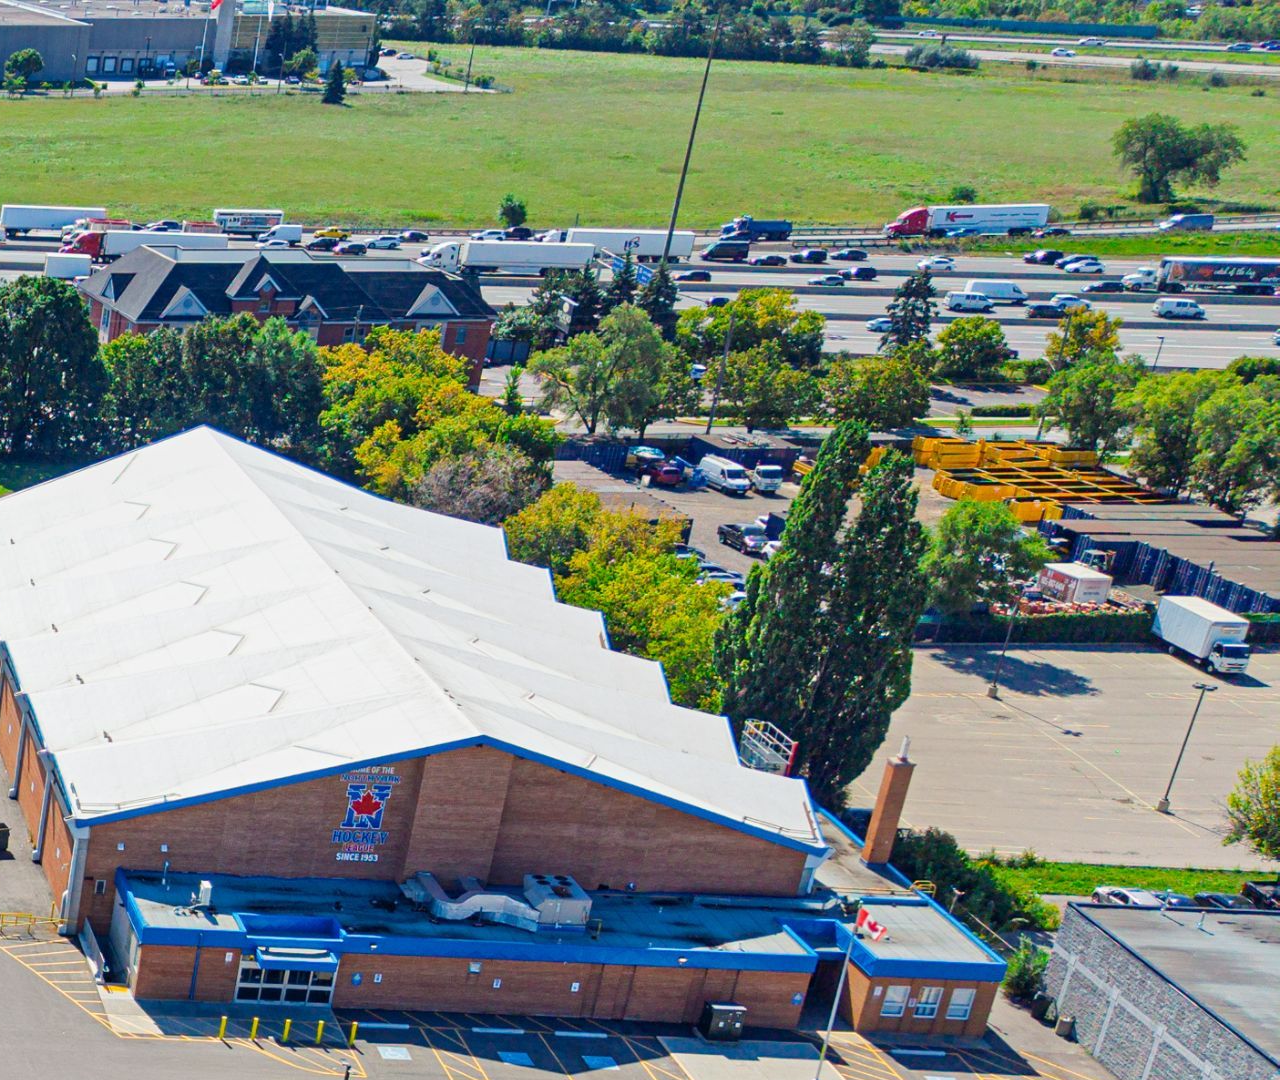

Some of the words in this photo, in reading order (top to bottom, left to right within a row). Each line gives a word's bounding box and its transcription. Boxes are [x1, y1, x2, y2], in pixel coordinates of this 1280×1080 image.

[331, 829, 389, 846] HOCKEY
[336, 852, 359, 861] SINCE
[360, 853, 378, 862] 1953
